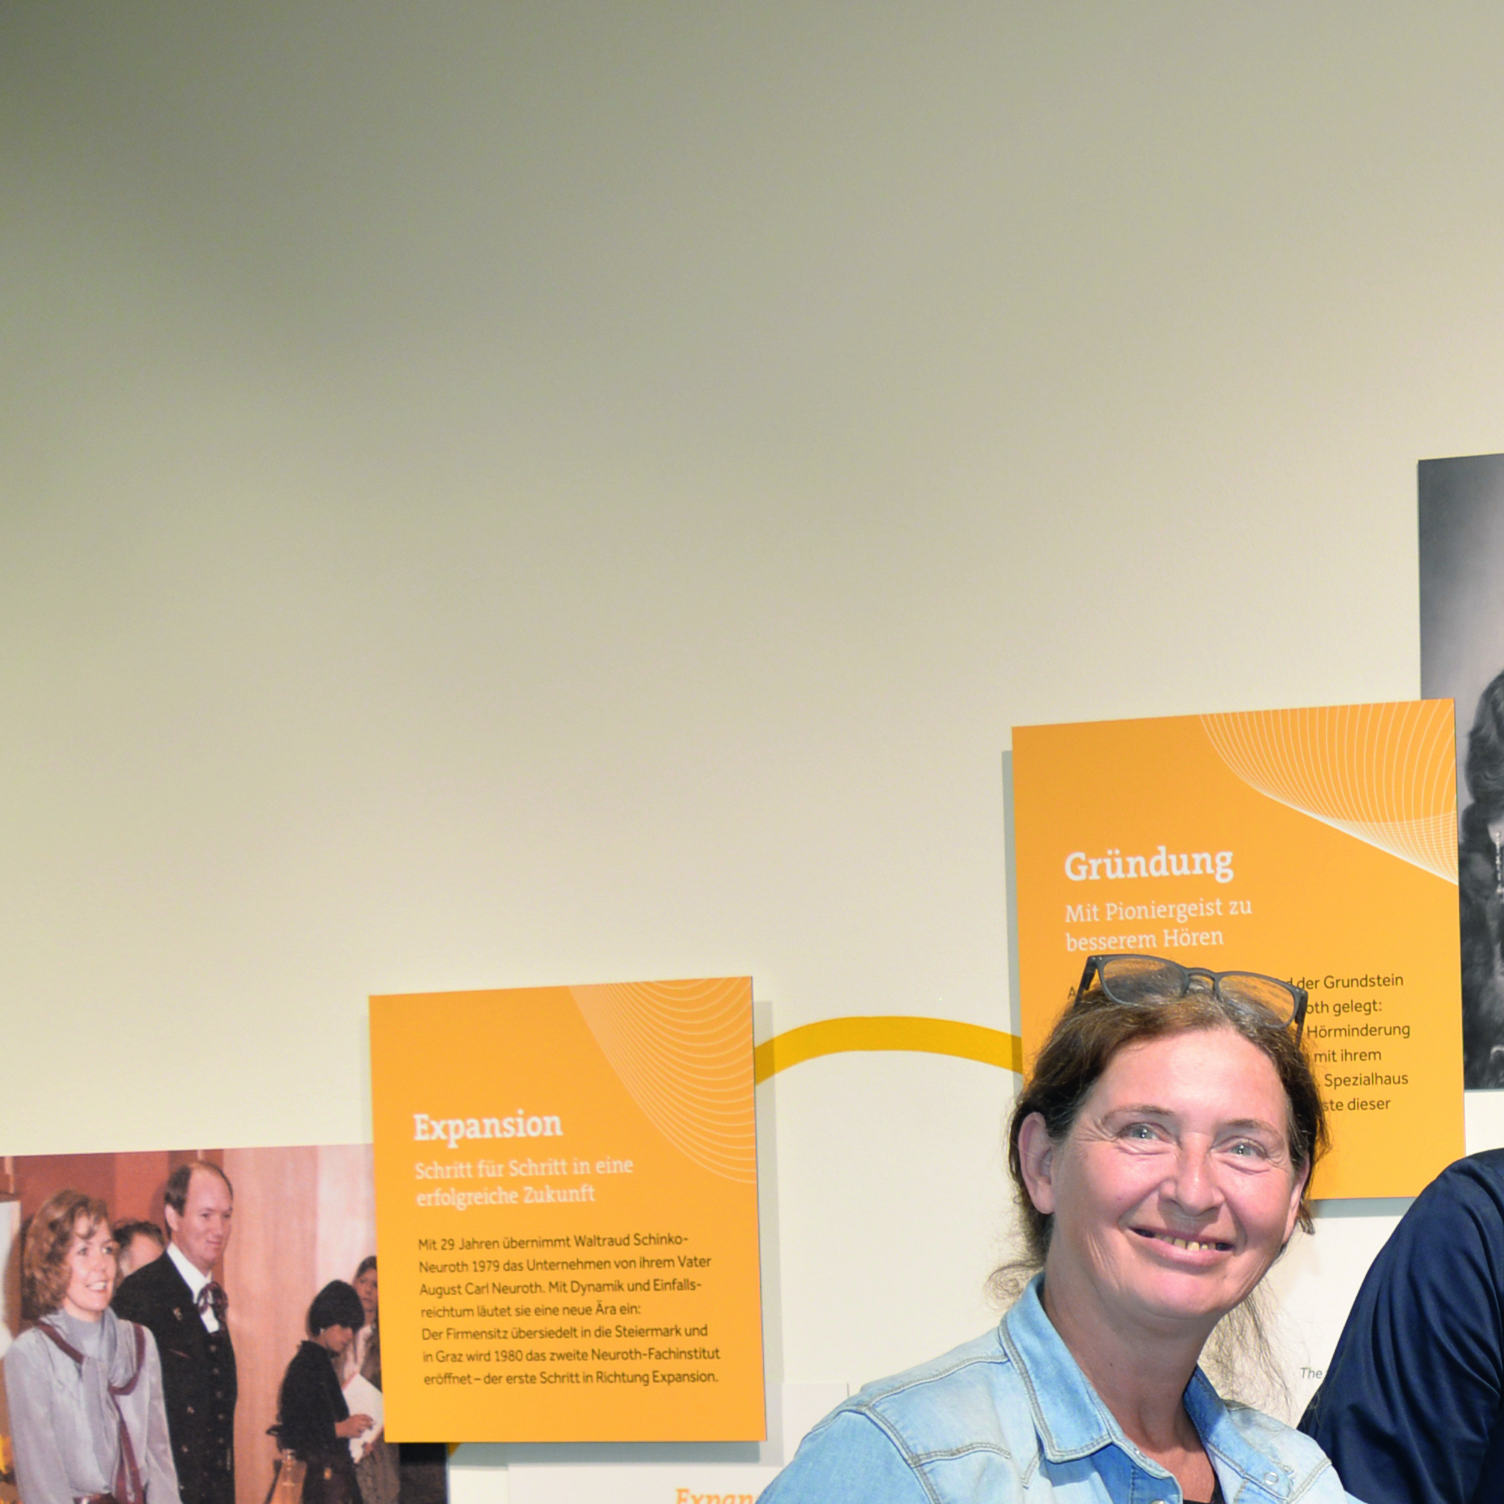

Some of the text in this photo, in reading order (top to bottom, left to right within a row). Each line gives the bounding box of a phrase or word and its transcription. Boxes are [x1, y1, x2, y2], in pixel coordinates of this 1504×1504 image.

[1064, 846, 1234, 883] Gründung
[1065, 899, 1252, 923] Mit Pioniergeist zu
[1066, 928, 1224, 952] besserem Hören
[1323, 974, 1403, 989] Grundstein
[1333, 1000, 1382, 1016] gelegt:
[1308, 1024, 1410, 1039] Hörminderung
[1314, 1049, 1381, 1062] mit ihrem
[1325, 1073, 1408, 1090] Spezialhaus
[1348, 1098, 1391, 1111] dieser
[413, 1109, 563, 1148] Expansion
[415, 1157, 633, 1180] Schritt für Schritt in eine
[417, 1184, 595, 1211] erfolgreiche Zukunft
[418, 1234, 688, 1251] Mit 29 Jahren übernimmt Waltraud Schinko-
[419, 1256, 712, 1273] Neuroth 1979 das Unternehmen von ihrem Vater
[420, 1278, 702, 1298] August Carl Neuroth. Mit Dynamik und Einfalls-
[421, 1300, 640, 1318] reichtum läutet sie eine neue Ära ein:
[422, 1324, 708, 1340] Der Firmensitz übersiedelt in die Steiermark und
[423, 1348, 720, 1362] in Graz wird 1980 das zweite Neuroth-Fachinstitut
[424, 1373, 472, 1385] eröffnet
[484, 1372, 502, 1384] der
[506, 1372, 536, 1384] erste
[540, 1372, 580, 1384] Schritt
[583, 1372, 594, 1384] in
[596, 1370, 649, 1386] Richtung
[652, 1370, 718, 1384] Expansion.
